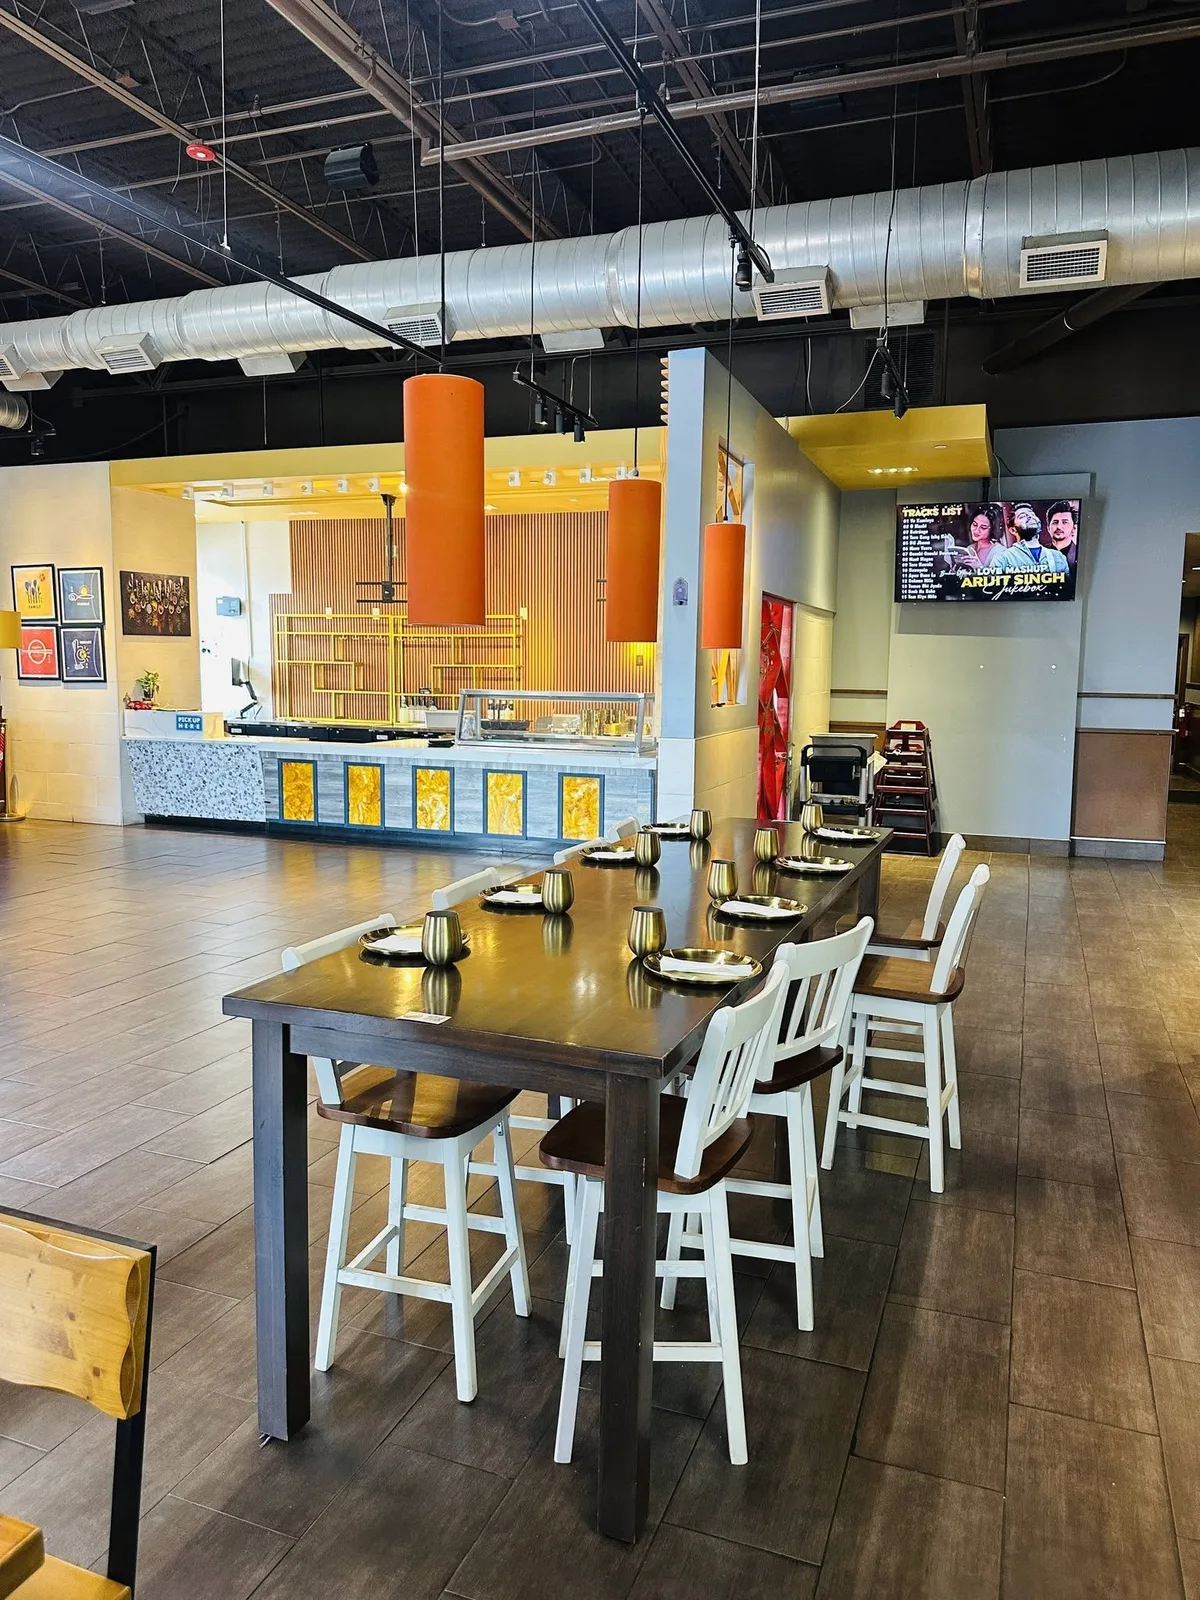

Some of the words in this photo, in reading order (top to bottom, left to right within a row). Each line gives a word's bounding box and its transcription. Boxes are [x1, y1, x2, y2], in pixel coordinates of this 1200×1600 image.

[902, 508, 939, 517] TRACKS
[942, 506, 962, 515] LIST
[977, 565, 1002, 576] LOVE
[1006, 564, 1048, 574] MASHUP
[960, 575, 1011, 588] ARIJIT
[1014, 572, 1065, 585] SINGH
[982, 581, 1047, 600] Jukebox
